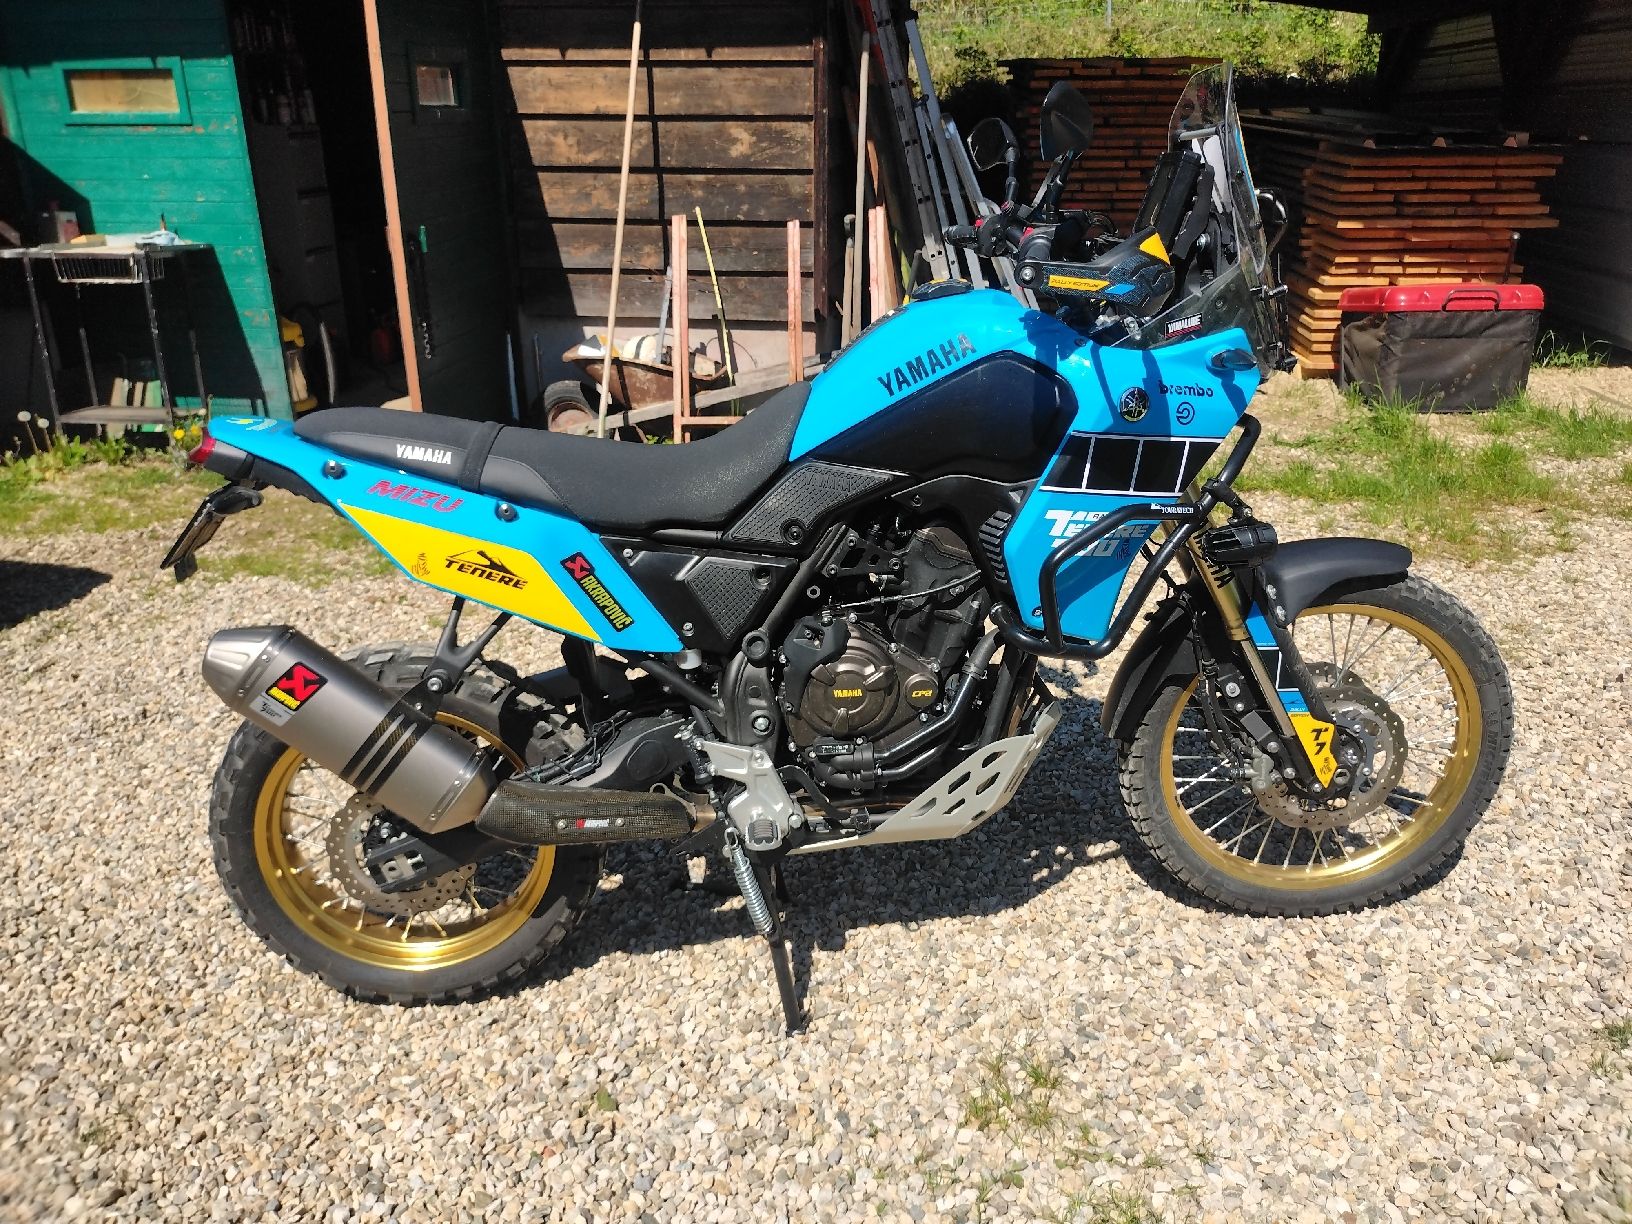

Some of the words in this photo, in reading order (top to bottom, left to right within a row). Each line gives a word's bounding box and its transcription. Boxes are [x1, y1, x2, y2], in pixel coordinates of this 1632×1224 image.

[877, 332, 977, 397] YAMAHA
[1158, 380, 1214, 398] brembo
[396, 443, 452, 464] YAMAHA
[368, 480, 464, 512] MIZU
[445, 557, 529, 590] TENERE
[834, 689, 862, 698] YAMAHA
